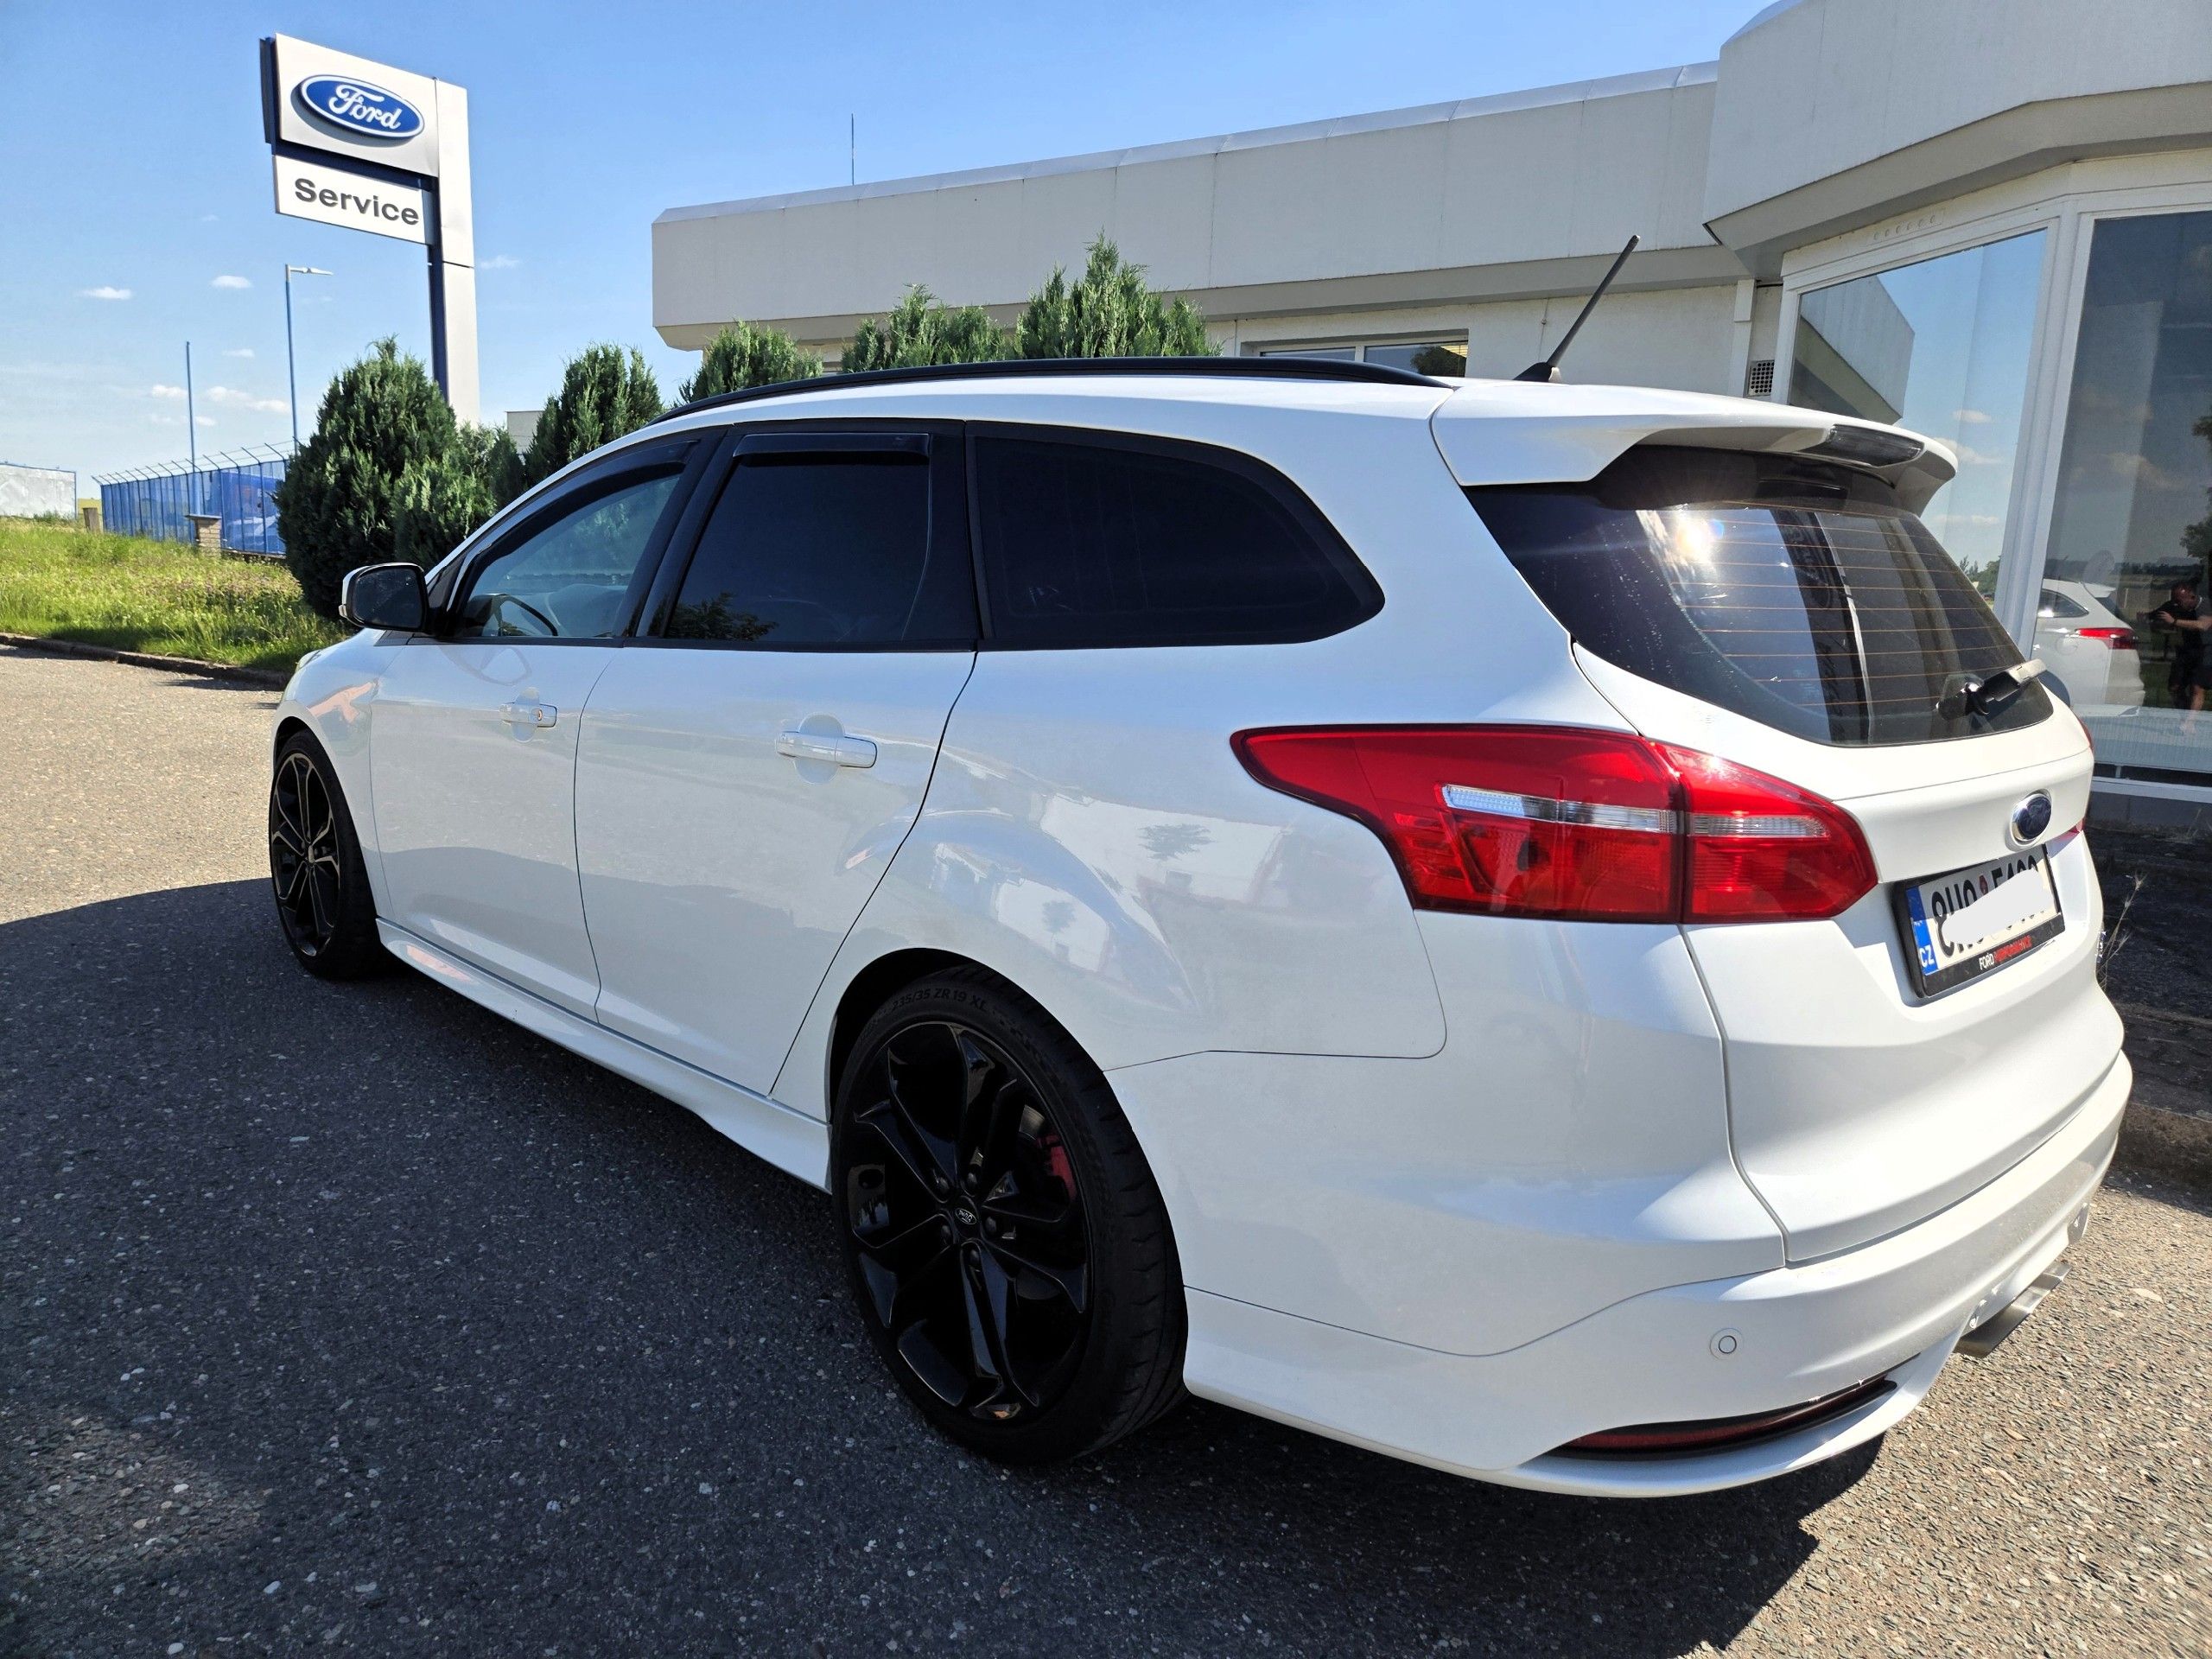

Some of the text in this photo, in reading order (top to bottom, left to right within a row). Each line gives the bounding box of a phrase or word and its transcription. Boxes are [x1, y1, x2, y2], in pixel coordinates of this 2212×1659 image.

[328, 85, 401, 130] Ford
[295, 177, 419, 226] Service
[1919, 944, 1936, 968] CZ
[953, 990, 967, 1002] 19
